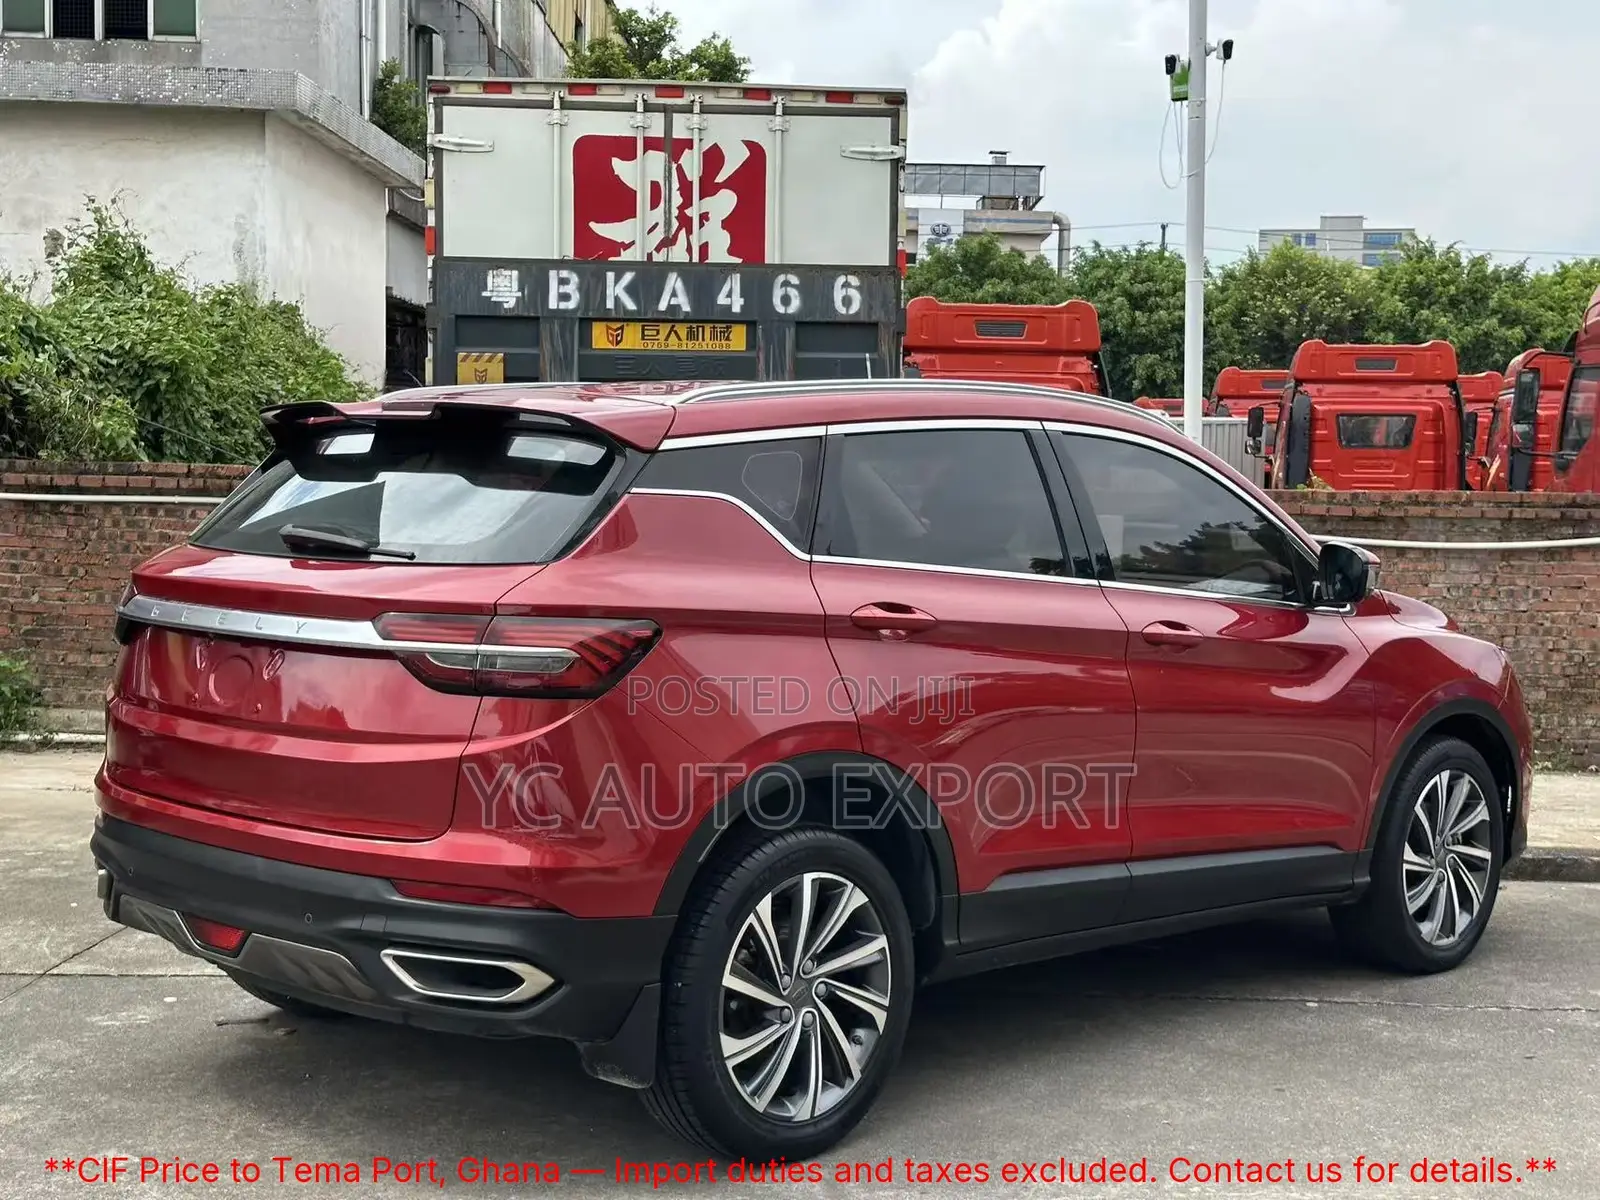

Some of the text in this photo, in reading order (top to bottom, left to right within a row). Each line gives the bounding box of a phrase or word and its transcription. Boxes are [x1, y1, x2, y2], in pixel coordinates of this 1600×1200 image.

[481, 268, 863, 315] 粤BKA466
[641, 324, 733, 342] 巨人机械
